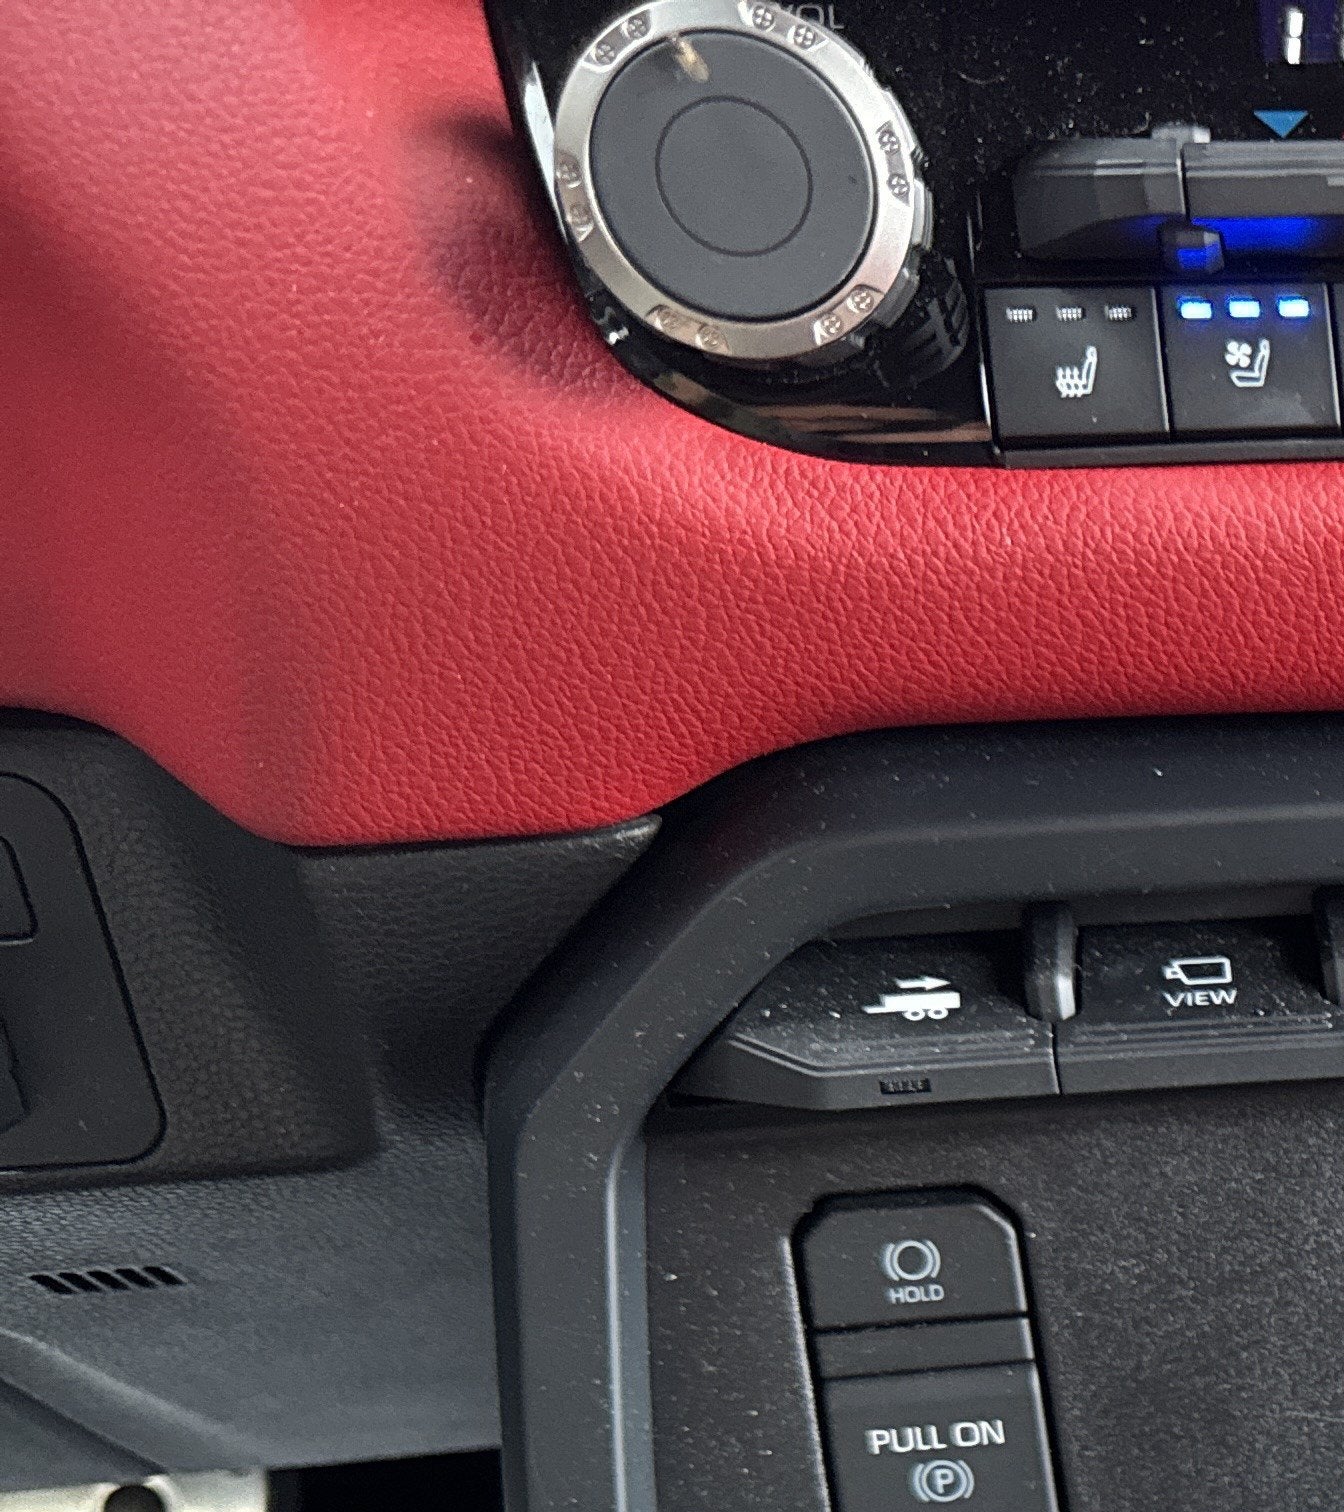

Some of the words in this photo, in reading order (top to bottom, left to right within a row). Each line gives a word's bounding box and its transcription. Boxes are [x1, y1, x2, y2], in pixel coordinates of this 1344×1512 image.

[785, 4, 844, 29] OL
[1163, 988, 1238, 1007] VIEW
[887, 1283, 945, 1304] HOLD
[865, 1424, 947, 1455] PULL
[951, 1419, 1006, 1448] ON
